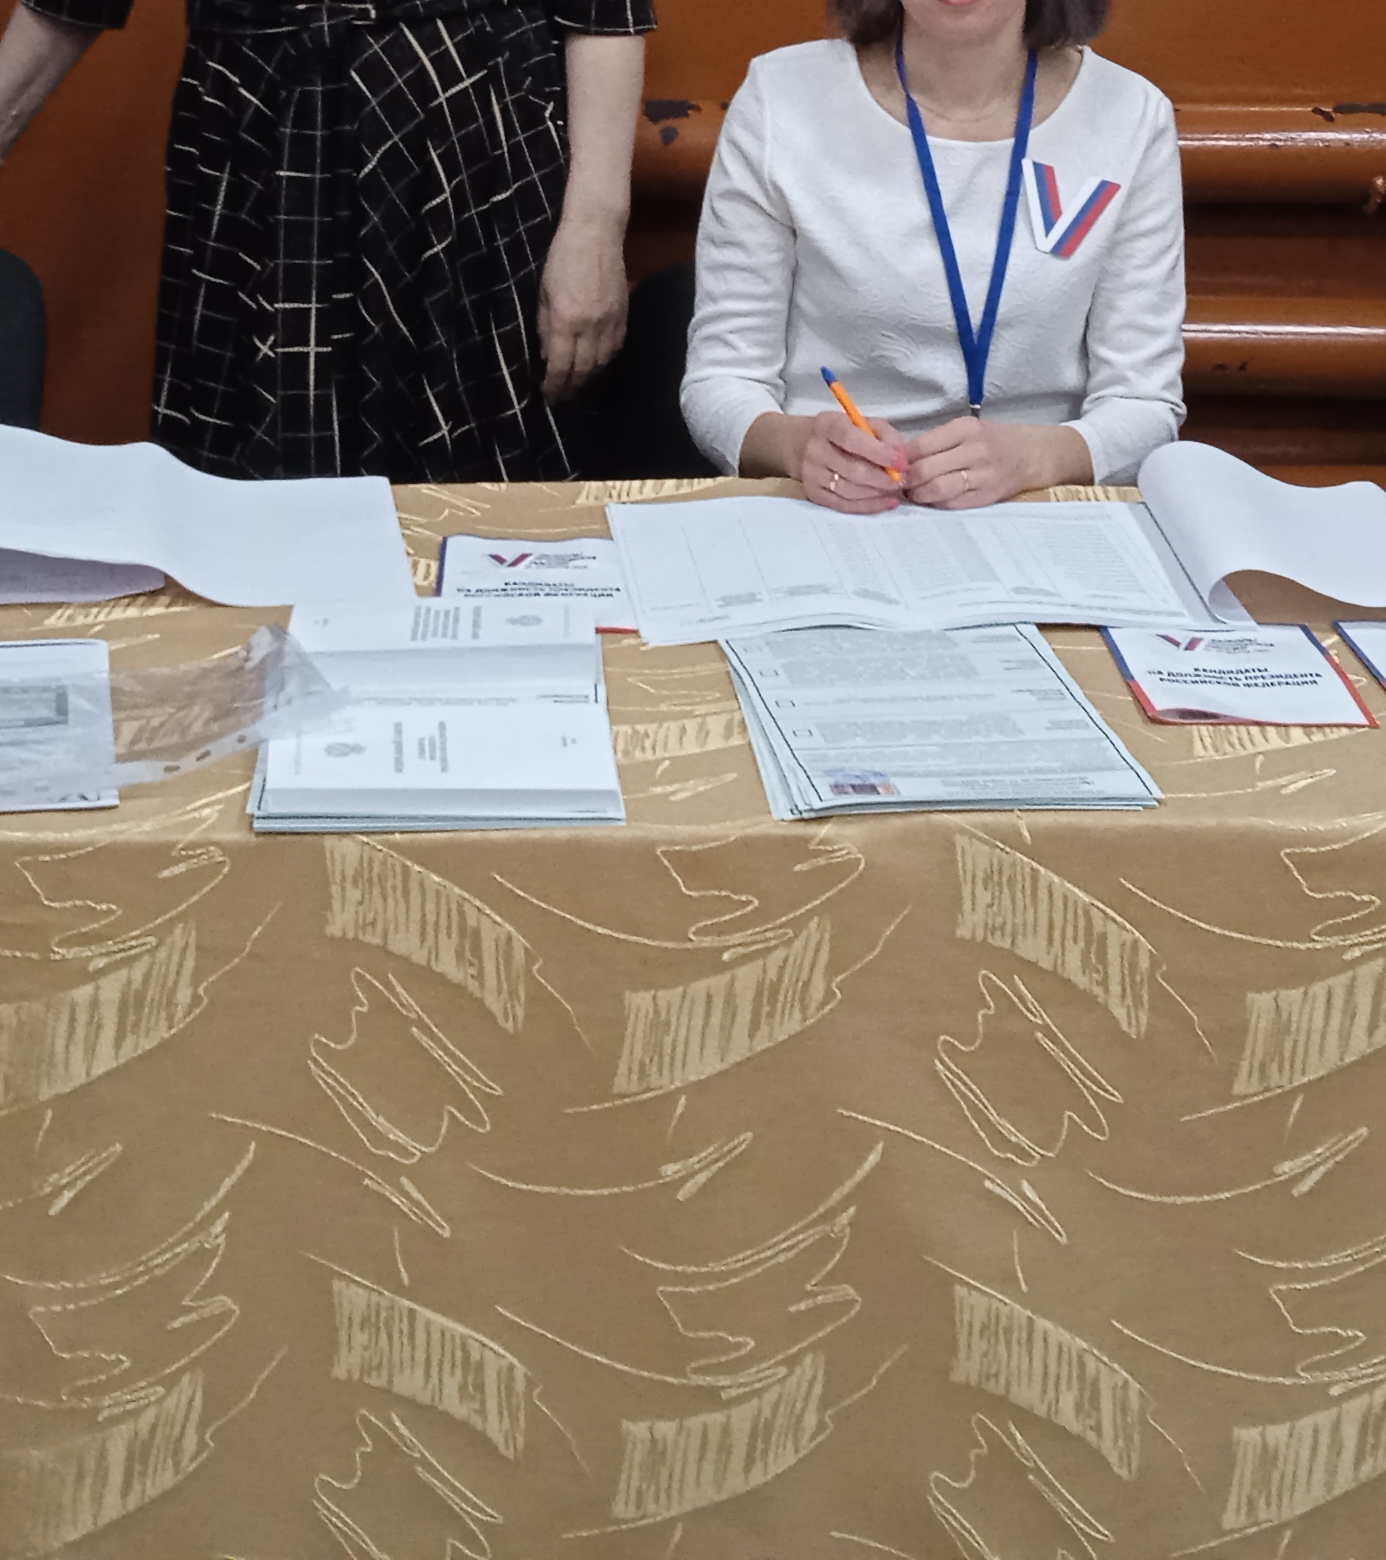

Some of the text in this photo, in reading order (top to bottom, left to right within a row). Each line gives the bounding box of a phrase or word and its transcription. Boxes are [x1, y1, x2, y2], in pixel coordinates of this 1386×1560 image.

[1166, 671, 1242, 682] ДОЛЖНОСТЬ
[1244, 672, 1323, 682] ПРЕЗИДЕНТА
[1193, 667, 1269, 676] КАНДИДАТЫ
[1158, 677, 1319, 689] РОССИЙСКОЙ ФЕДЕРАЦИИ
